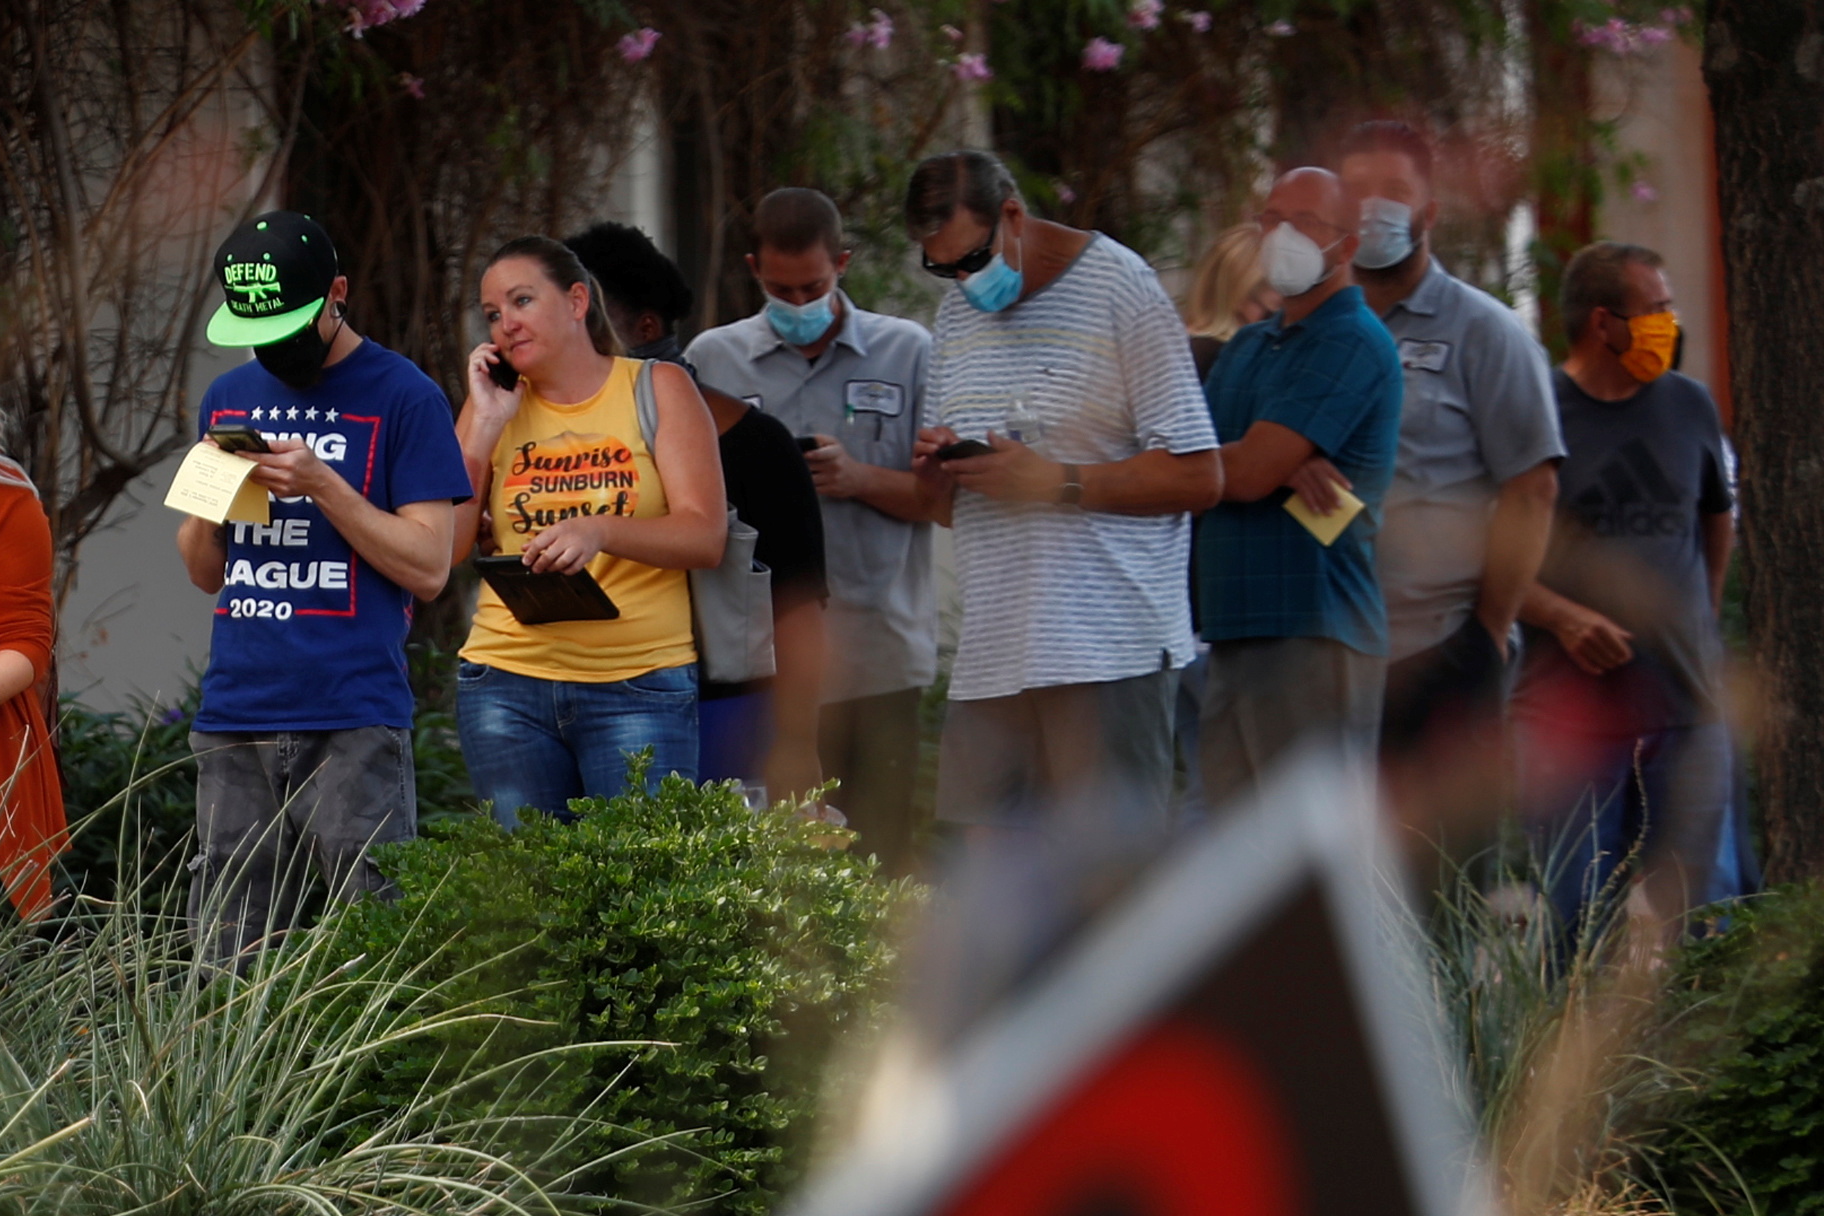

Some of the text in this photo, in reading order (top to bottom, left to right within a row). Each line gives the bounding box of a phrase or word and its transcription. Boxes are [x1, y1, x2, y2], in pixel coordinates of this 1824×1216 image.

[224, 262, 277, 285] DEFEND
[255, 297, 285, 313] METAL
[511, 441, 633, 476] Sunrise
[529, 471, 634, 494] SUNBURN
[229, 519, 311, 547] THE
[224, 558, 348, 589] AGUE
[229, 598, 293, 620] 2020
